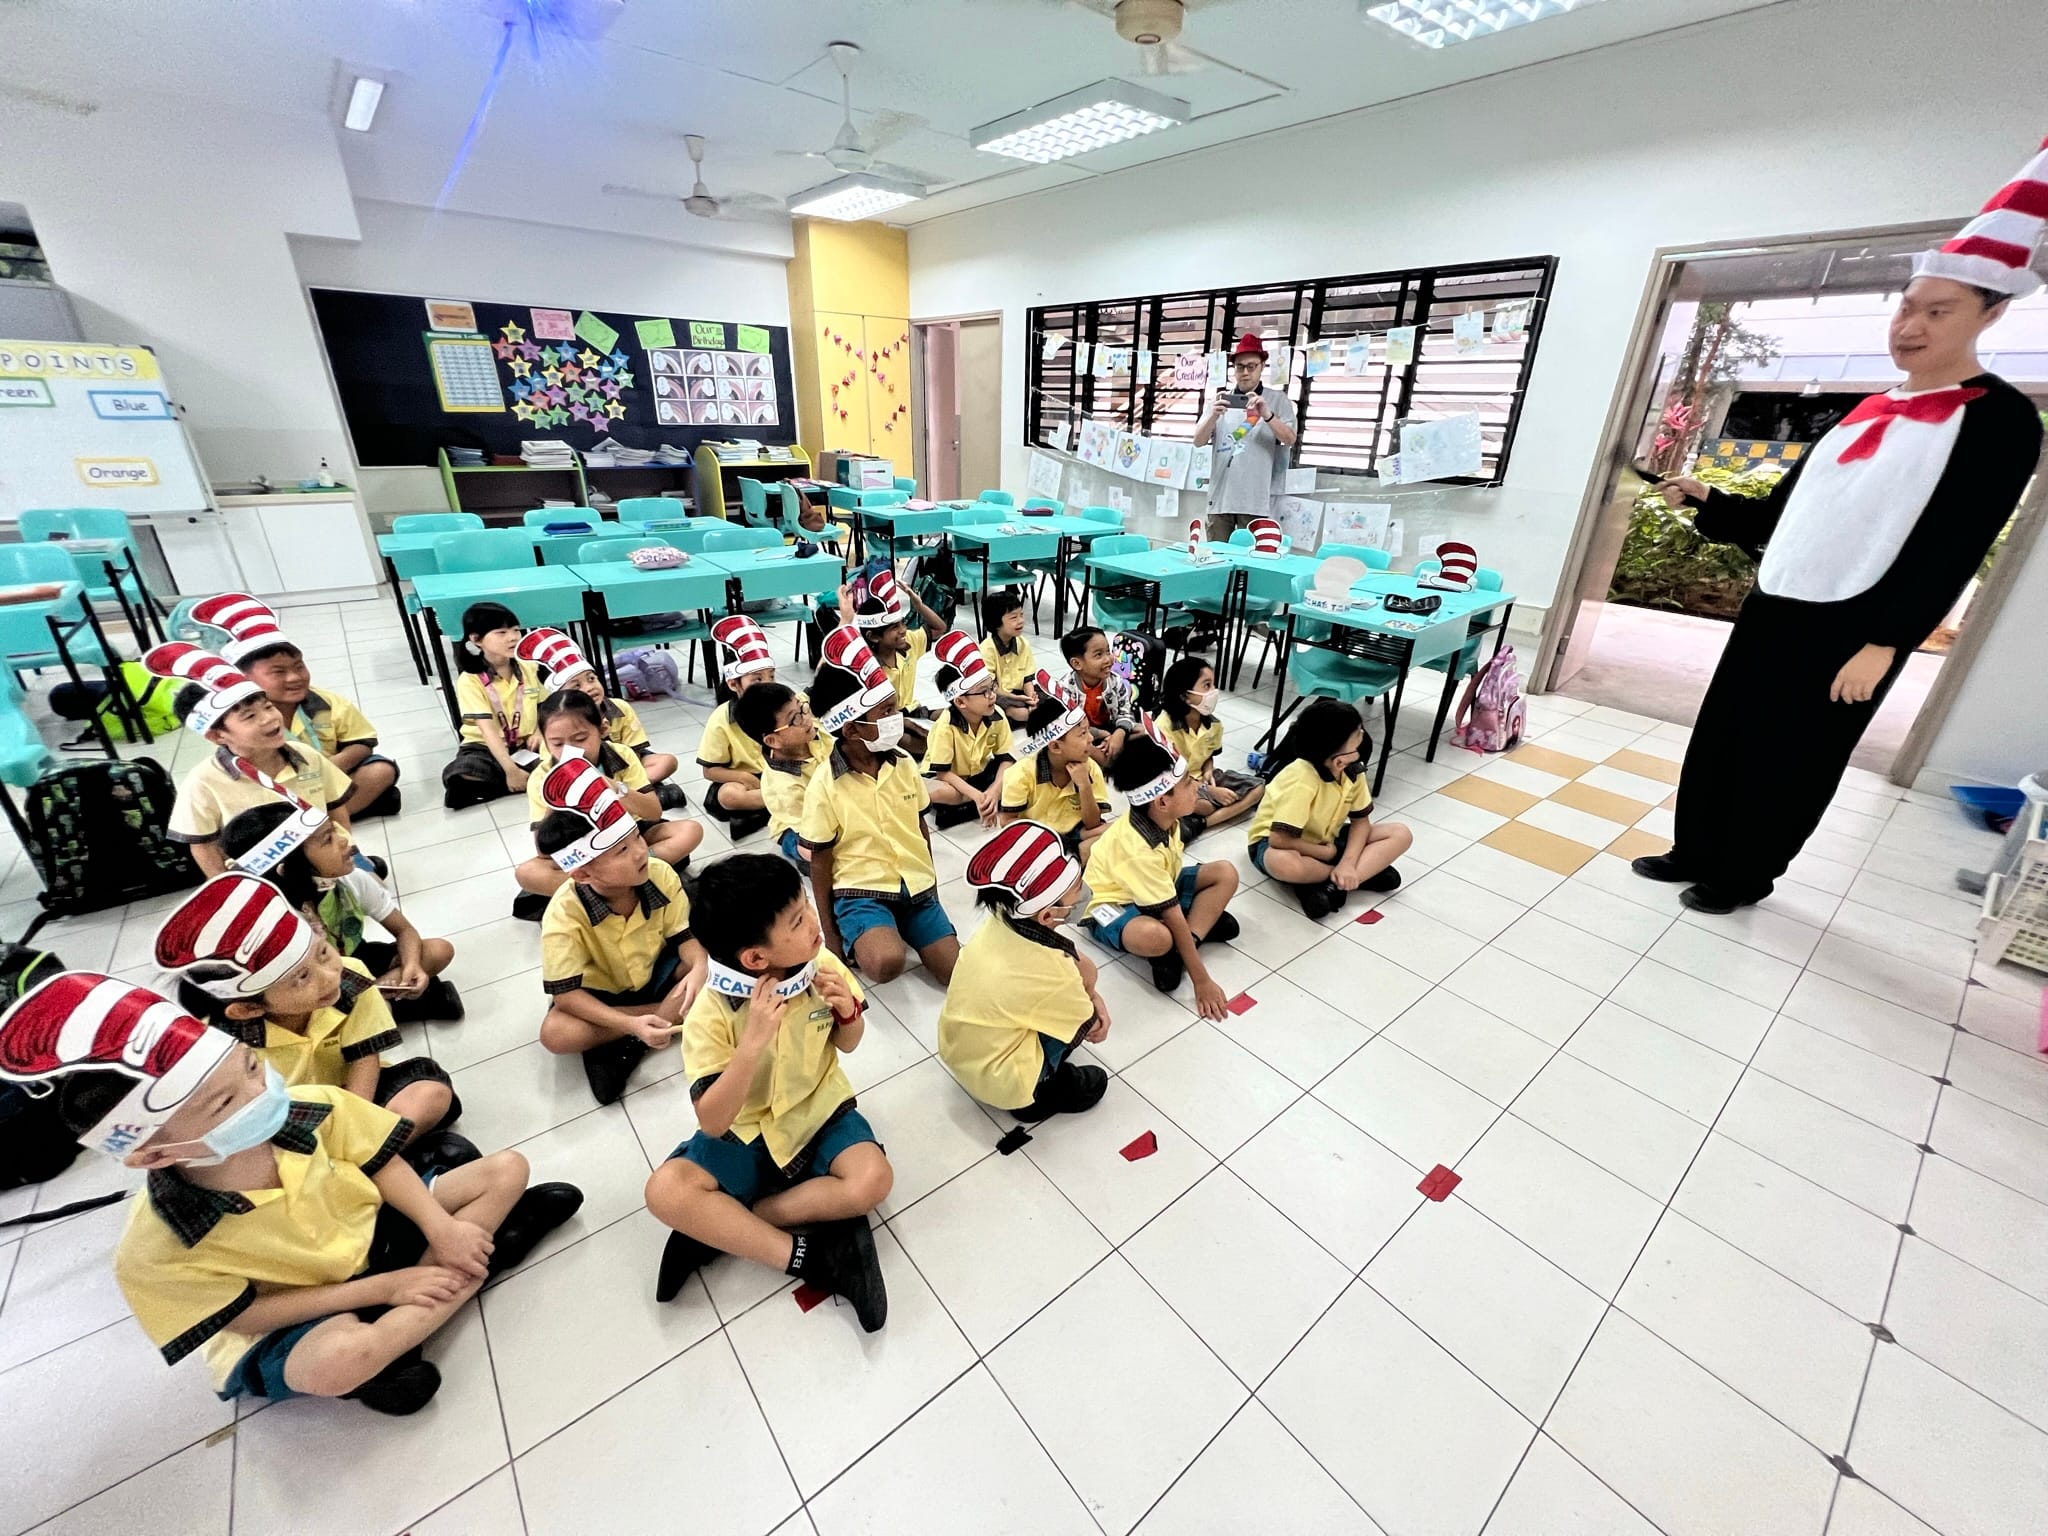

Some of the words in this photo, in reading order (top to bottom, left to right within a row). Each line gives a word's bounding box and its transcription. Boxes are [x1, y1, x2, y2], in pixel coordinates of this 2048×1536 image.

[695, 323, 714, 335] Our
[0, 353, 134, 371] POINTS
[1181, 356, 1196, 367] Our
[113, 399, 149, 412] Blue
[89, 467, 148, 480] Orange
[831, 706, 852, 727] HAT
[1043, 726, 1060, 742] HAT
[1144, 780, 1167, 799] HAT
[264, 832, 297, 860] HAT
[560, 850, 582, 867] HAT
[720, 977, 755, 995] CAT
[792, 1236, 806, 1269] BRPS
